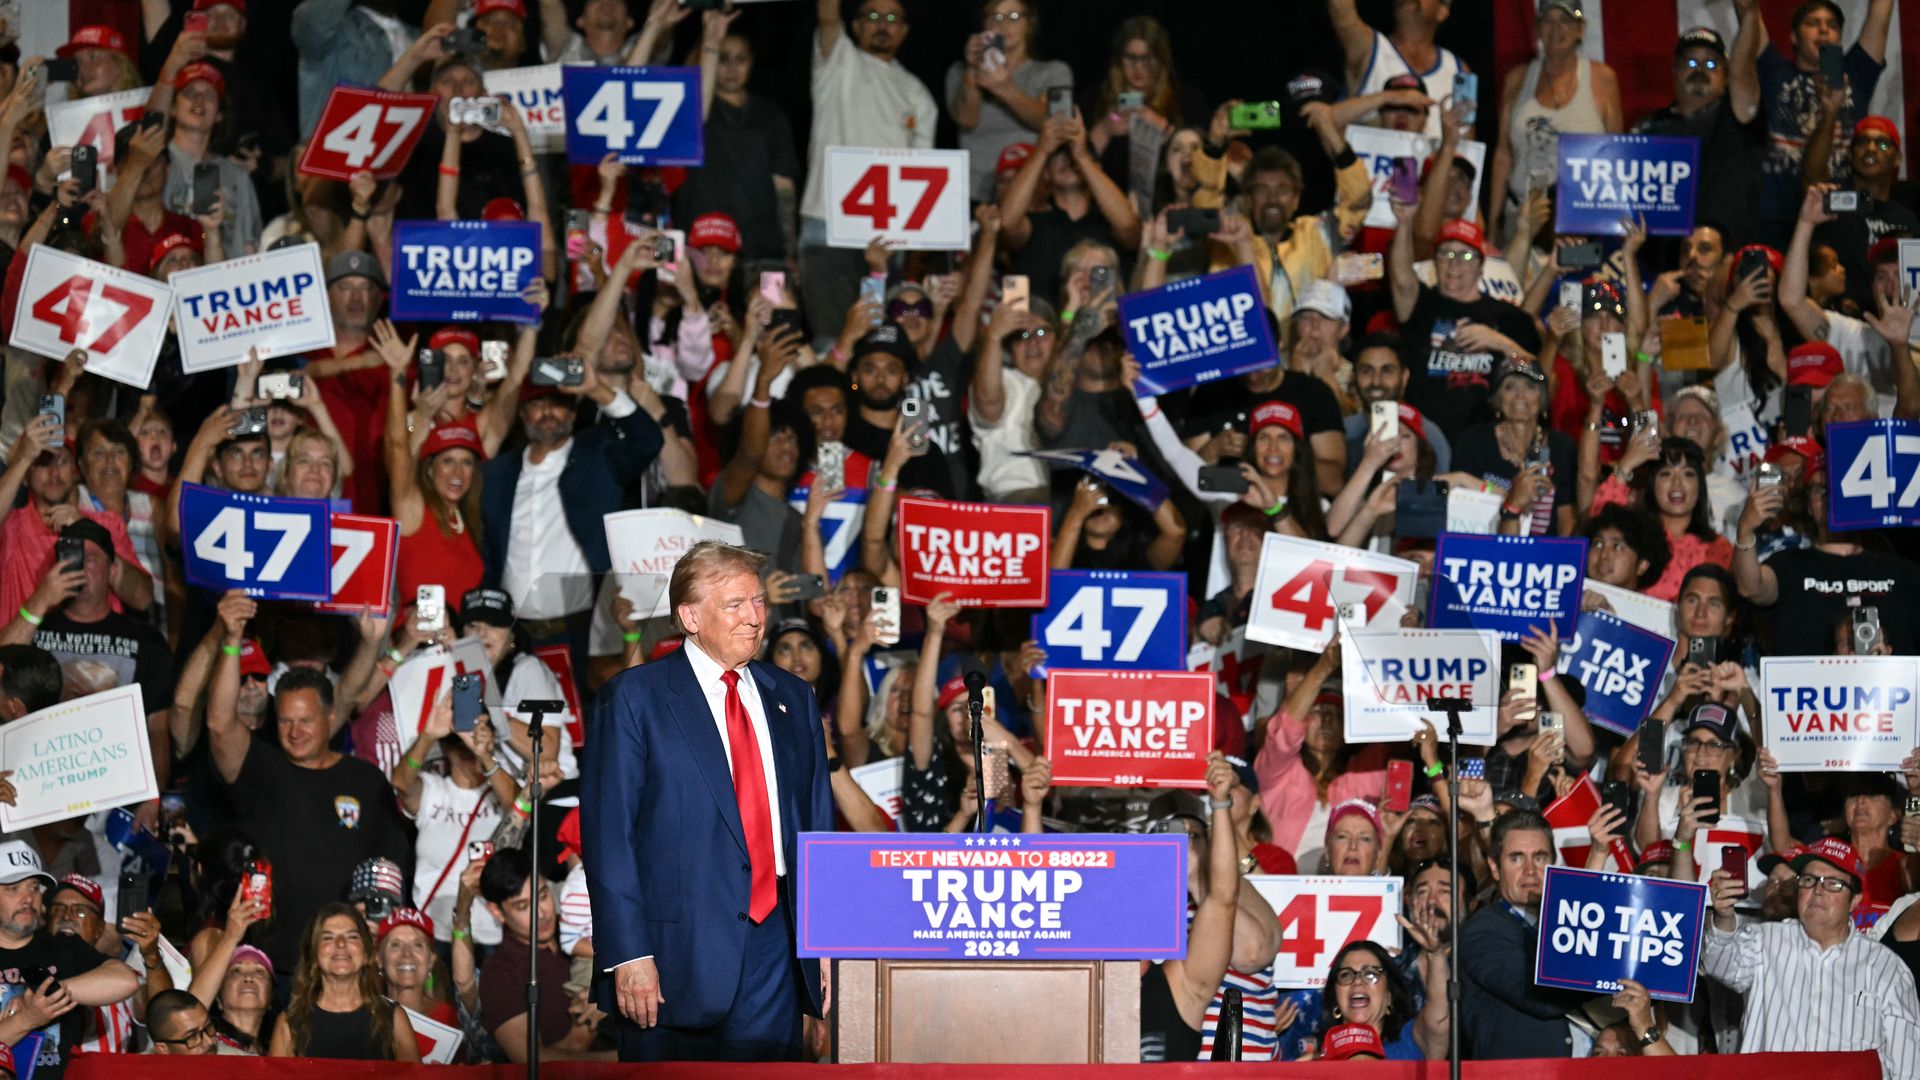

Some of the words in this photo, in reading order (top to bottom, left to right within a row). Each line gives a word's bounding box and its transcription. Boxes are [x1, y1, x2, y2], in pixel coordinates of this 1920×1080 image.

[575, 80, 685, 149] 47
[322, 103, 415, 169] 47
[1566, 157, 1691, 185] TRUMP
[841, 164, 949, 231] 47
[1580, 181, 1676, 203] VANCE
[401, 245, 534, 272] TRUMP
[183, 272, 313, 317] TRUMP
[416, 269, 519, 291] VANCE
[32, 274, 154, 356] 47
[202, 297, 304, 334] VANCE
[1129, 292, 1254, 343] TRUMP
[1146, 318, 1248, 359] VANCE
[194, 506, 311, 582] 47
[905, 524, 1041, 558] TRUMP
[918, 551, 1024, 577] VANCE
[1444, 557, 1577, 590] TRUMP
[1271, 559, 1399, 631] 47
[1457, 583, 1561, 610] VANCE
[1045, 586, 1168, 662] 47
[1472, 605, 1510, 616] AMERICA
[1511, 609, 1537, 619] GREAT
[1357, 658, 1487, 683] TRUMP
[1591, 638, 1651, 682] TAX
[1373, 683, 1474, 705] VANCE
[1579, 659, 1645, 706] TIPS
[1057, 698, 1205, 728] TRUMP
[1771, 686, 1911, 711] TRUMP
[1786, 712, 1894, 733] VANCE
[33, 727, 104, 757] LATINO
[1073, 726, 1187, 750] VANCE
[15, 742, 128, 784] AMERICANS
[1064, 749, 1090, 757] MAKE
[1091, 749, 1131, 758] AMERICA
[1133, 750, 1162, 759] GREAT
[1164, 751, 1195, 759] AGAIN!
[58, 767, 108, 787] TRUMP
[1113, 775, 1143, 785] 2024
[7, 852, 40, 868] USA
[879, 851, 927, 867] TEXT
[932, 851, 1013, 867] NEVADA
[1018, 851, 1043, 867] TO
[1048, 851, 1108, 867] 88022
[903, 869, 1083, 902] TRUMP
[922, 902, 1062, 929] VANCE
[1557, 899, 1605, 929] NO
[1615, 905, 1685, 939] TAX
[913, 930, 943, 939] MAKE
[946, 930, 993, 939] AMERICA
[996, 930, 1031, 939] GREAT
[1034, 930, 1071, 939] AGAIN!
[1277, 894, 1383, 969] 47
[1552, 926, 1599, 957] ON
[1608, 932, 1684, 967] TIPS
[964, 940, 1020, 957] 2024
